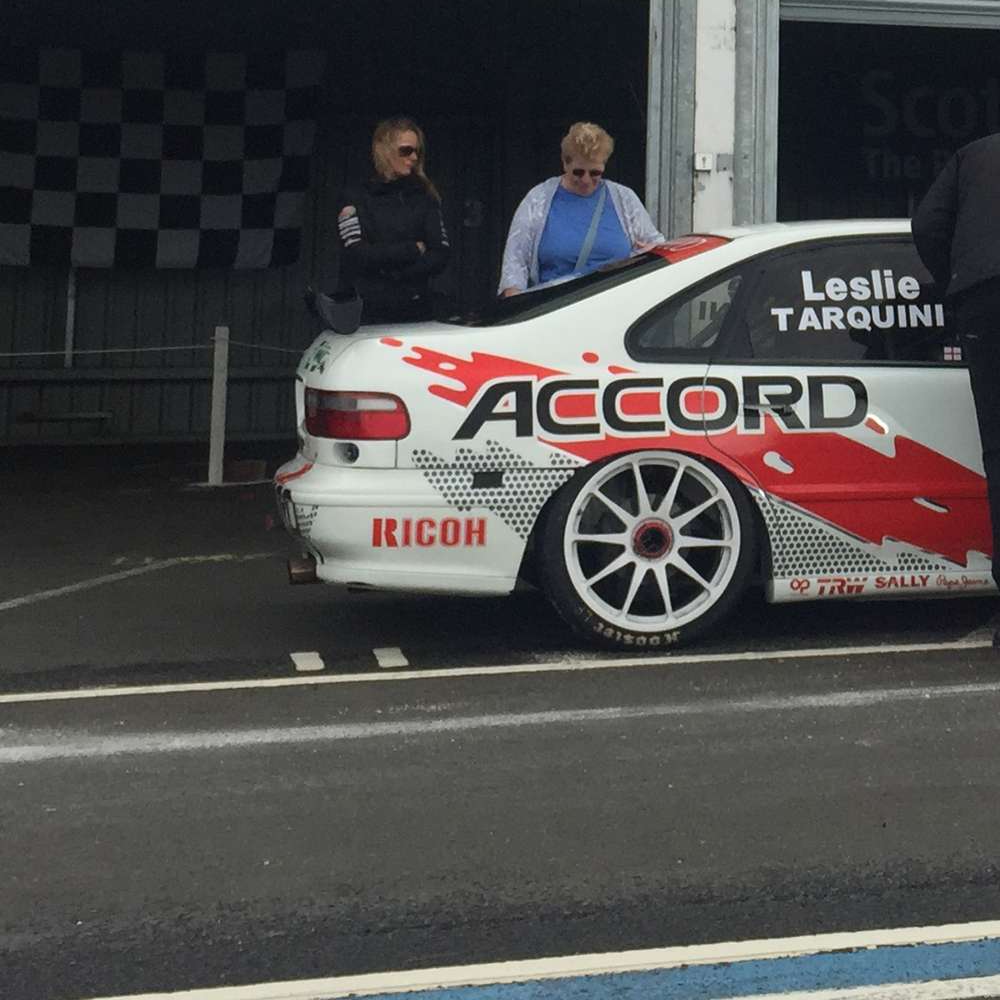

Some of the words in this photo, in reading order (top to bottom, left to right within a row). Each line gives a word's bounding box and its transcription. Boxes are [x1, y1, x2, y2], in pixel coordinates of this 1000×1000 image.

[801, 269, 920, 302] Leslie
[771, 304, 944, 331] TARQUINI
[452, 375, 868, 440] ACCORD
[371, 517, 488, 548] RICOH
[874, 574, 930, 589] SALLY
